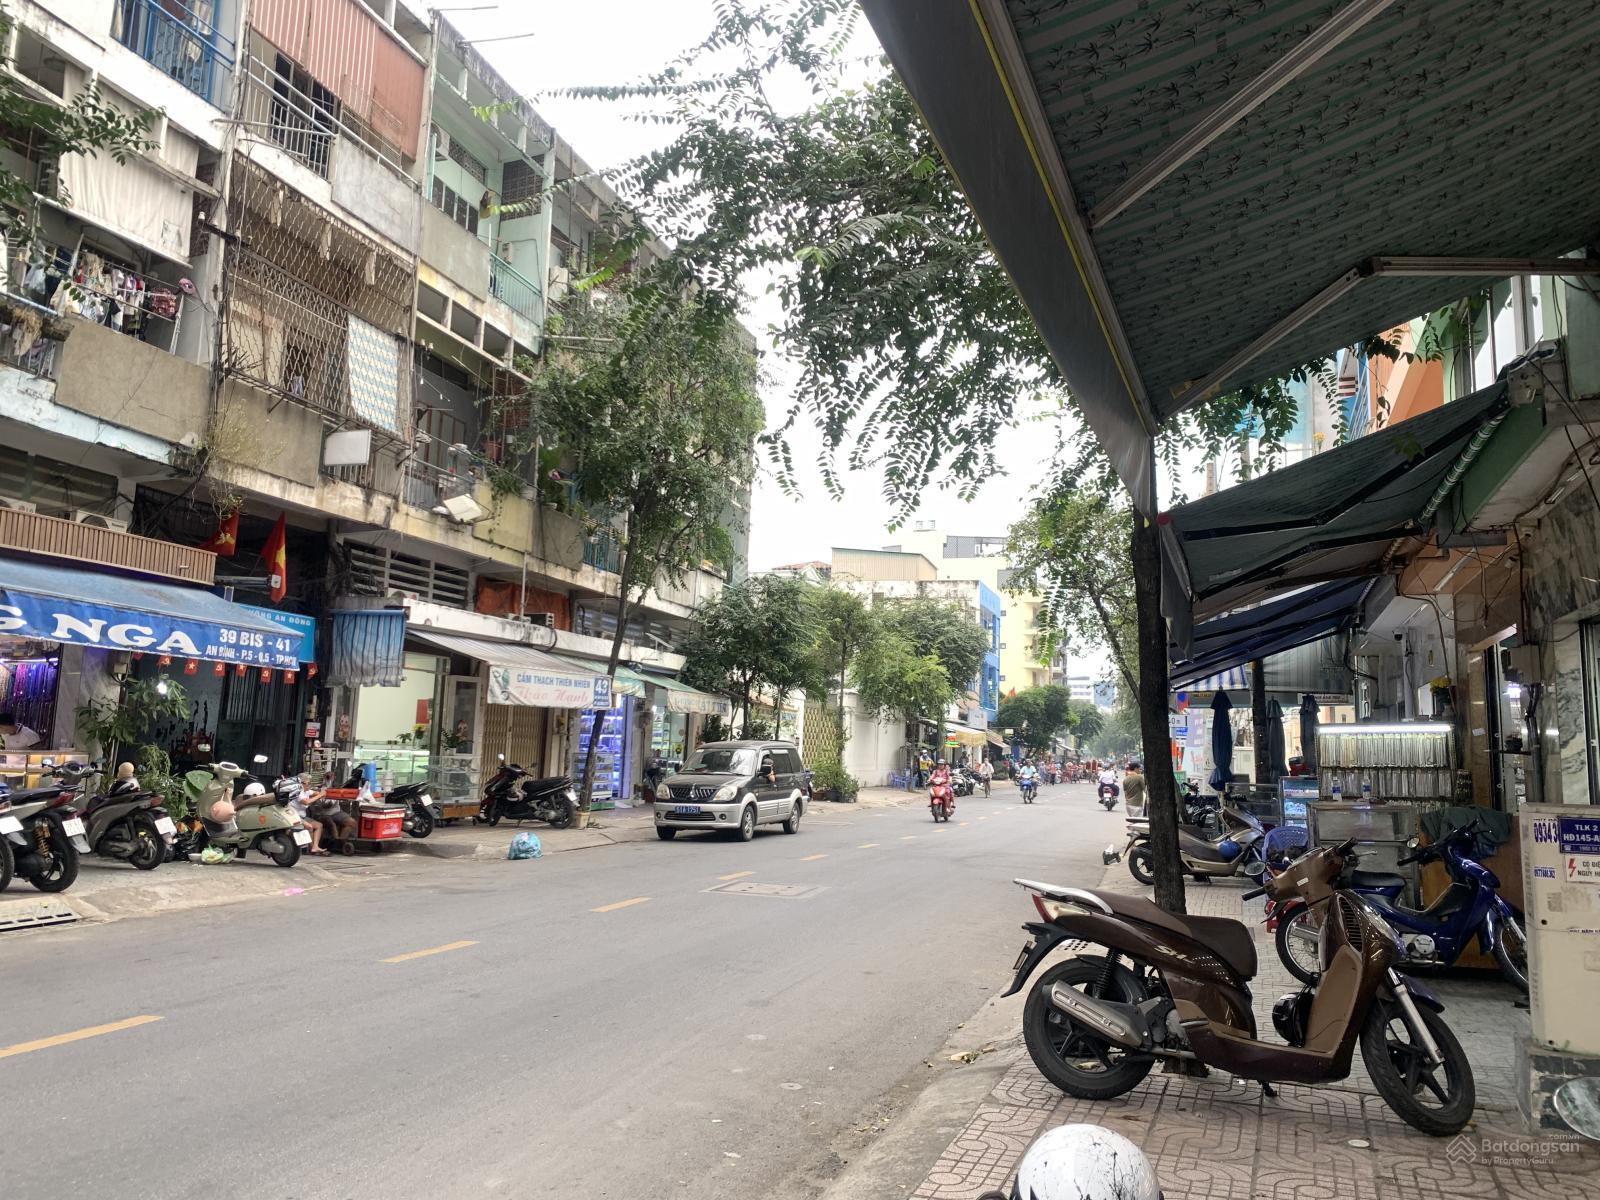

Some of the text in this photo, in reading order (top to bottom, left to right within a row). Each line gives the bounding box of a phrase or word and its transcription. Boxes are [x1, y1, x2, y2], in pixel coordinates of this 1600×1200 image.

[51, 613, 202, 655] NGA
[219, 628, 237, 644] 39
[239, 631, 263, 648] BIS
[275, 638, 290, 652] 41
[205, 645, 218, 656] AN
[241, 649, 253, 661] P.5
[595, 679, 608, 694] 43
[1563, 833, 1600, 843] HĐ145-A
